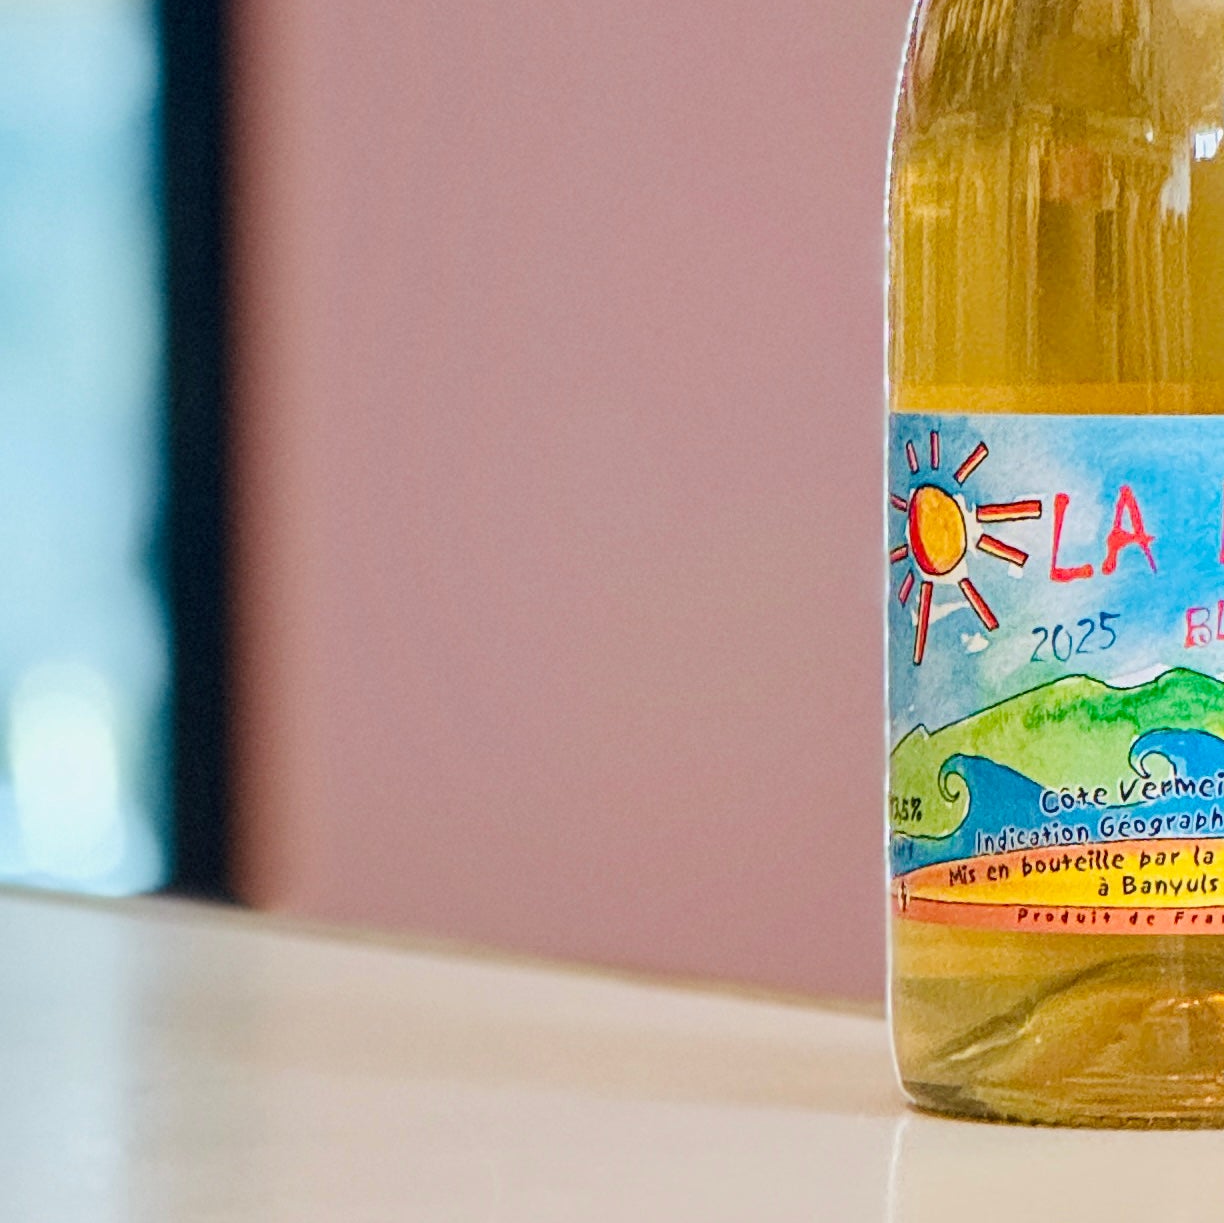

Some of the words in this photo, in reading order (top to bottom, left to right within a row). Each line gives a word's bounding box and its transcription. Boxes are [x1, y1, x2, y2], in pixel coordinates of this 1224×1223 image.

[1050, 485, 1157, 582] LA
[1030, 613, 1120, 663] 2025
[1042, 787, 1108, 813] Côte
[977, 823, 1089, 855] Indication
[949, 865, 976, 886] Mis
[987, 863, 1009, 881] en
[1022, 849, 1125, 877] bouteille
[1140, 849, 1181, 870] par
[1194, 846, 1214, 866] la
[1098, 877, 1109, 897] à
[1122, 874, 1219, 897] Banyuls
[1017, 908, 1111, 926] Produit
[1129, 911, 1156, 926] de
